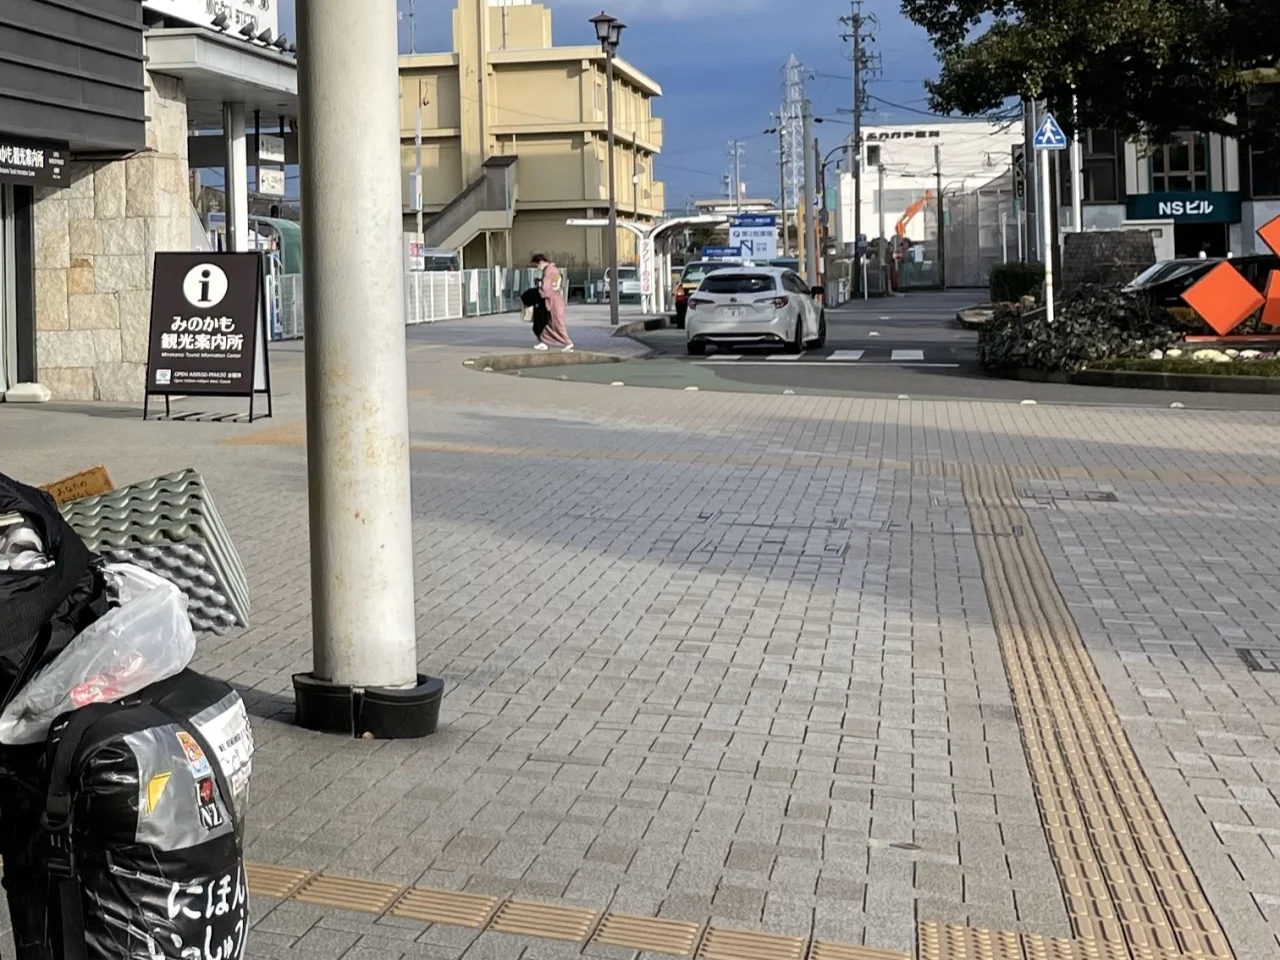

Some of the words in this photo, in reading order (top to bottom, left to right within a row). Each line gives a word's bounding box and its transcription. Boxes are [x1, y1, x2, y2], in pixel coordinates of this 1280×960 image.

[170, 316, 235, 332] みのかも
[161, 333, 244, 350] 観光案内所
[200, 803, 223, 830] NZ
[167, 865, 246, 920] にほん
